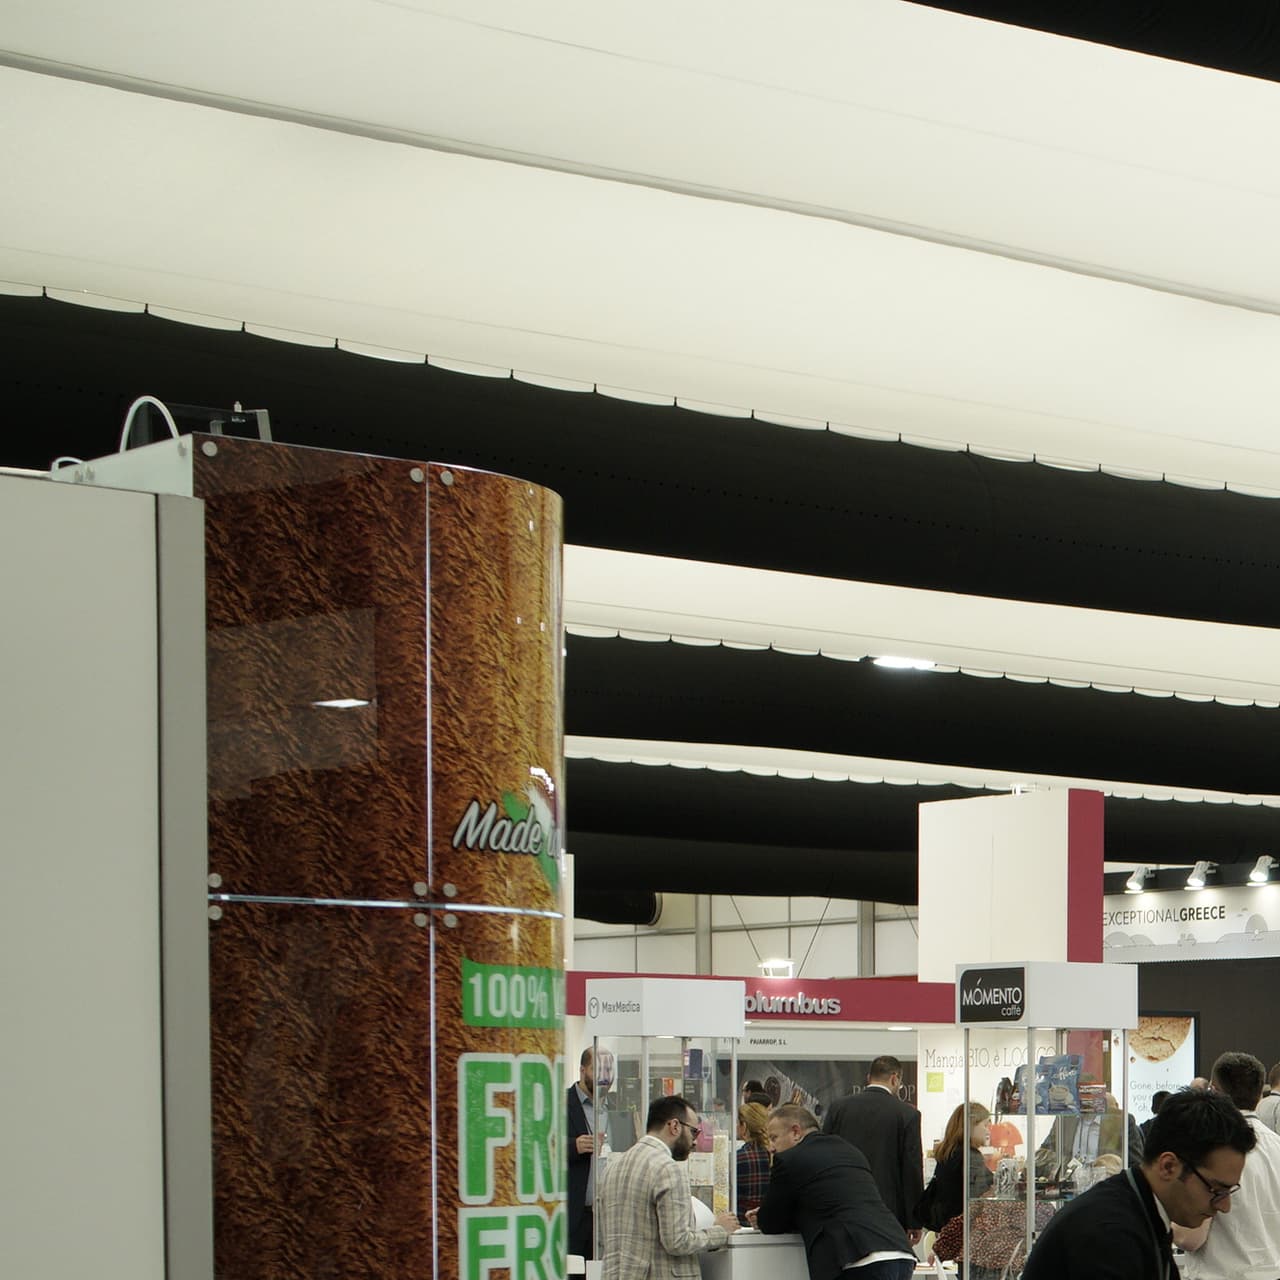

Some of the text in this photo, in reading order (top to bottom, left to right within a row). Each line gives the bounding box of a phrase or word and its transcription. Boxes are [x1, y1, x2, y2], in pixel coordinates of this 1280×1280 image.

[453, 799, 542, 854] Made
[468, 972, 548, 1020] 100%
[602, 1000, 640, 1013] MaxMedica
[925, 1048, 964, 1074] Mangia
